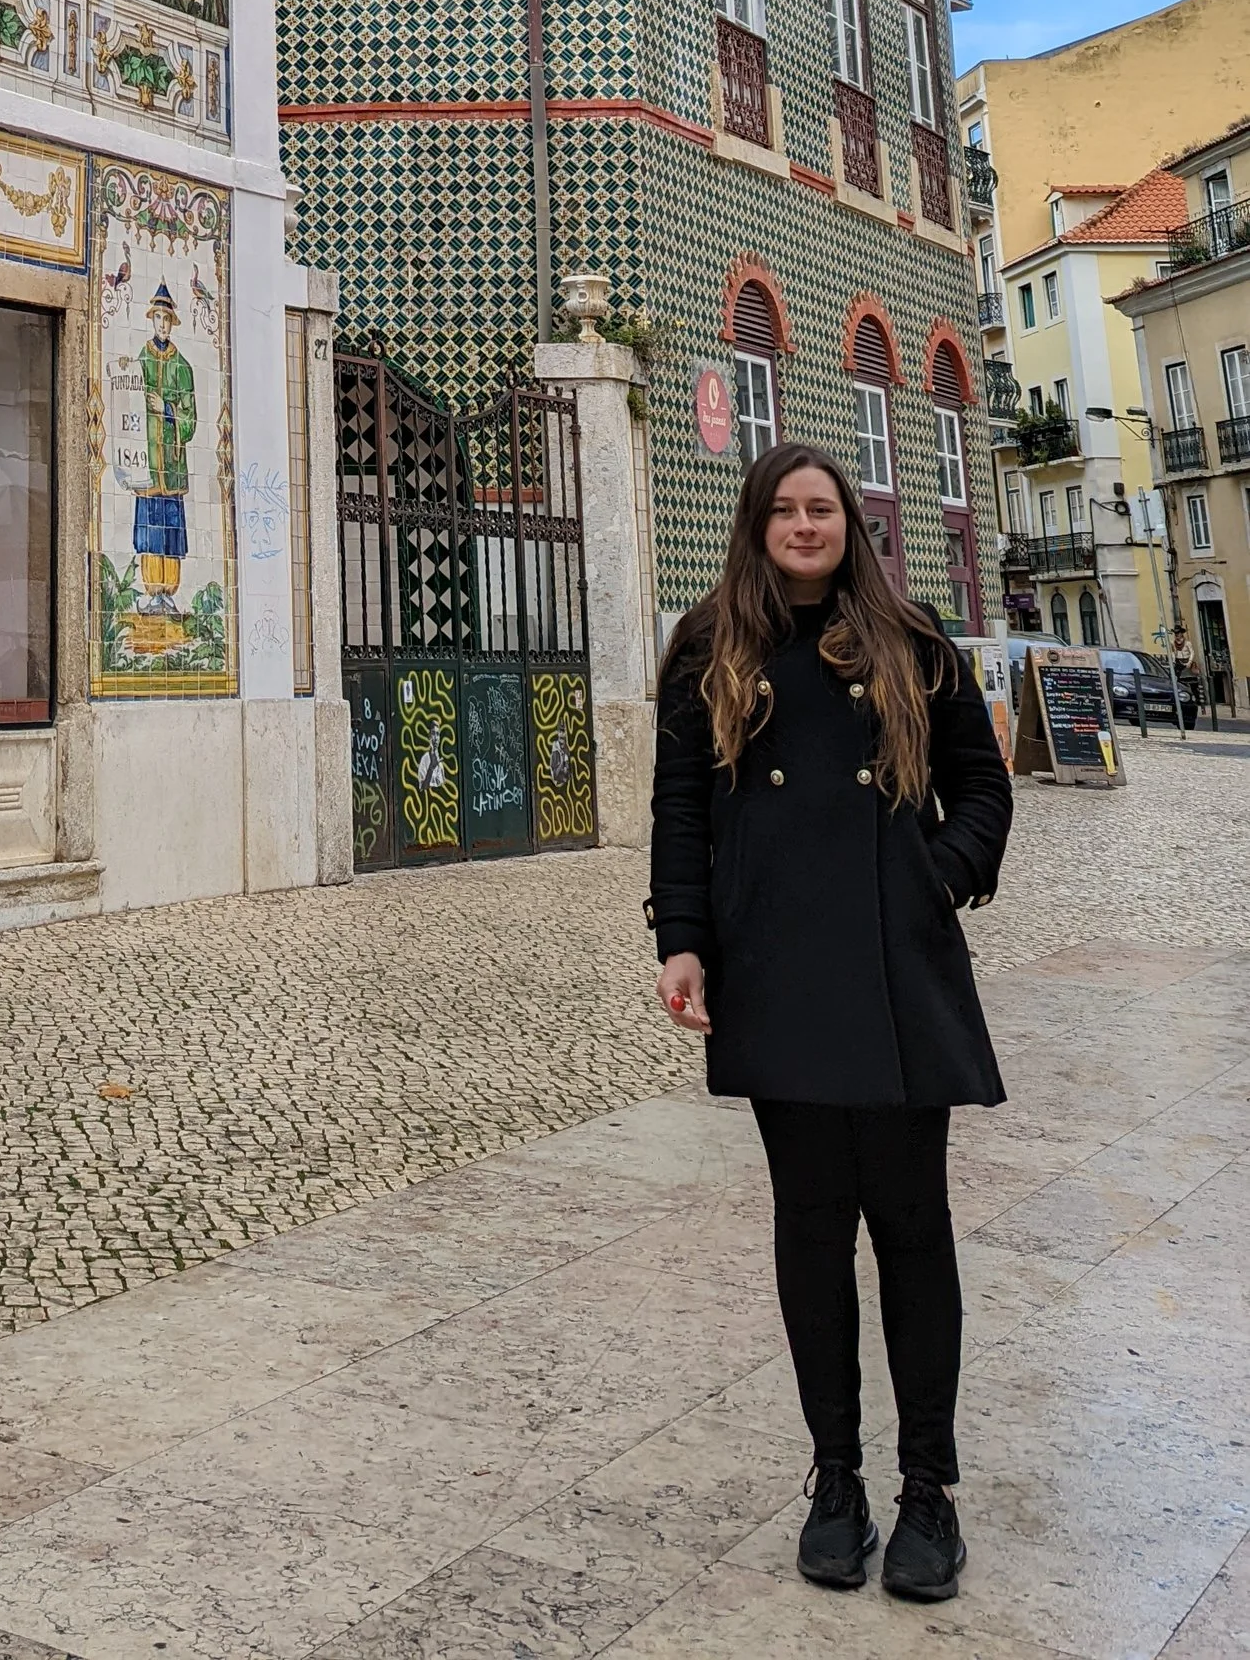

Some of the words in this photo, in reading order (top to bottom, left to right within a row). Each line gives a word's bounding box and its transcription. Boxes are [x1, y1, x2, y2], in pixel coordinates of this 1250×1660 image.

[314, 338, 328, 360] 27
[111, 374, 145, 391] FUNDADA
[117, 446, 147, 469] 1849
